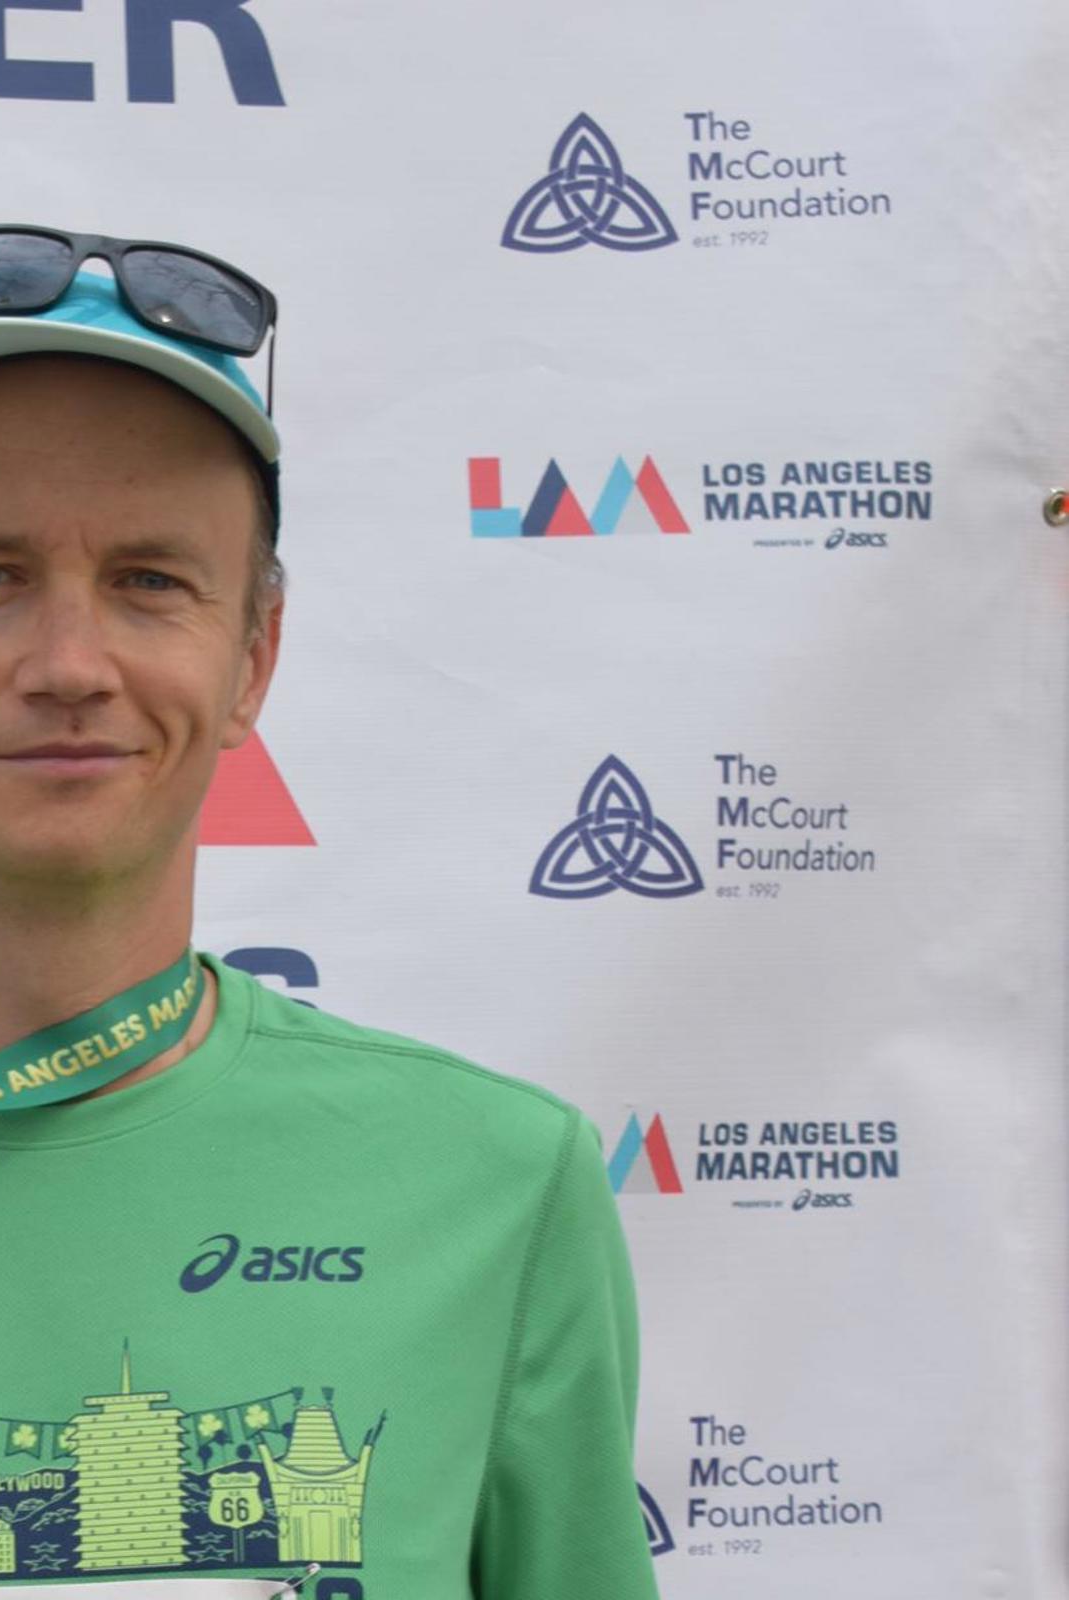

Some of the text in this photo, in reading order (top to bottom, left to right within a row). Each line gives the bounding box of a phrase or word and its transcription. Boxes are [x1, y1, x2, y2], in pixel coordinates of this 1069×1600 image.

[684, 112, 750, 141] The
[689, 150, 846, 181] McCourt
[691, 188, 890, 220] Foundation
[730, 230, 768, 245] 1992
[703, 461, 932, 487] LOS ANGELES
[705, 490, 931, 520] MARATHON
[714, 754, 776, 786] The
[718, 797, 847, 829] McCourt
[718, 839, 874, 871] Foundation
[749, 883, 780, 898] 1992
[8, 1014, 147, 1094] ANGELES
[699, 1121, 897, 1146] LOS ANGELES
[696, 1150, 898, 1180] MARATHON
[241, 1247, 365, 1282] asics
[690, 1416, 745, 1446] The
[690, 1456, 838, 1487] McCourt
[221, 1497, 250, 1522] 66
[688, 1494, 882, 1528] Foundation
[724, 1539, 762, 1554] 1992
